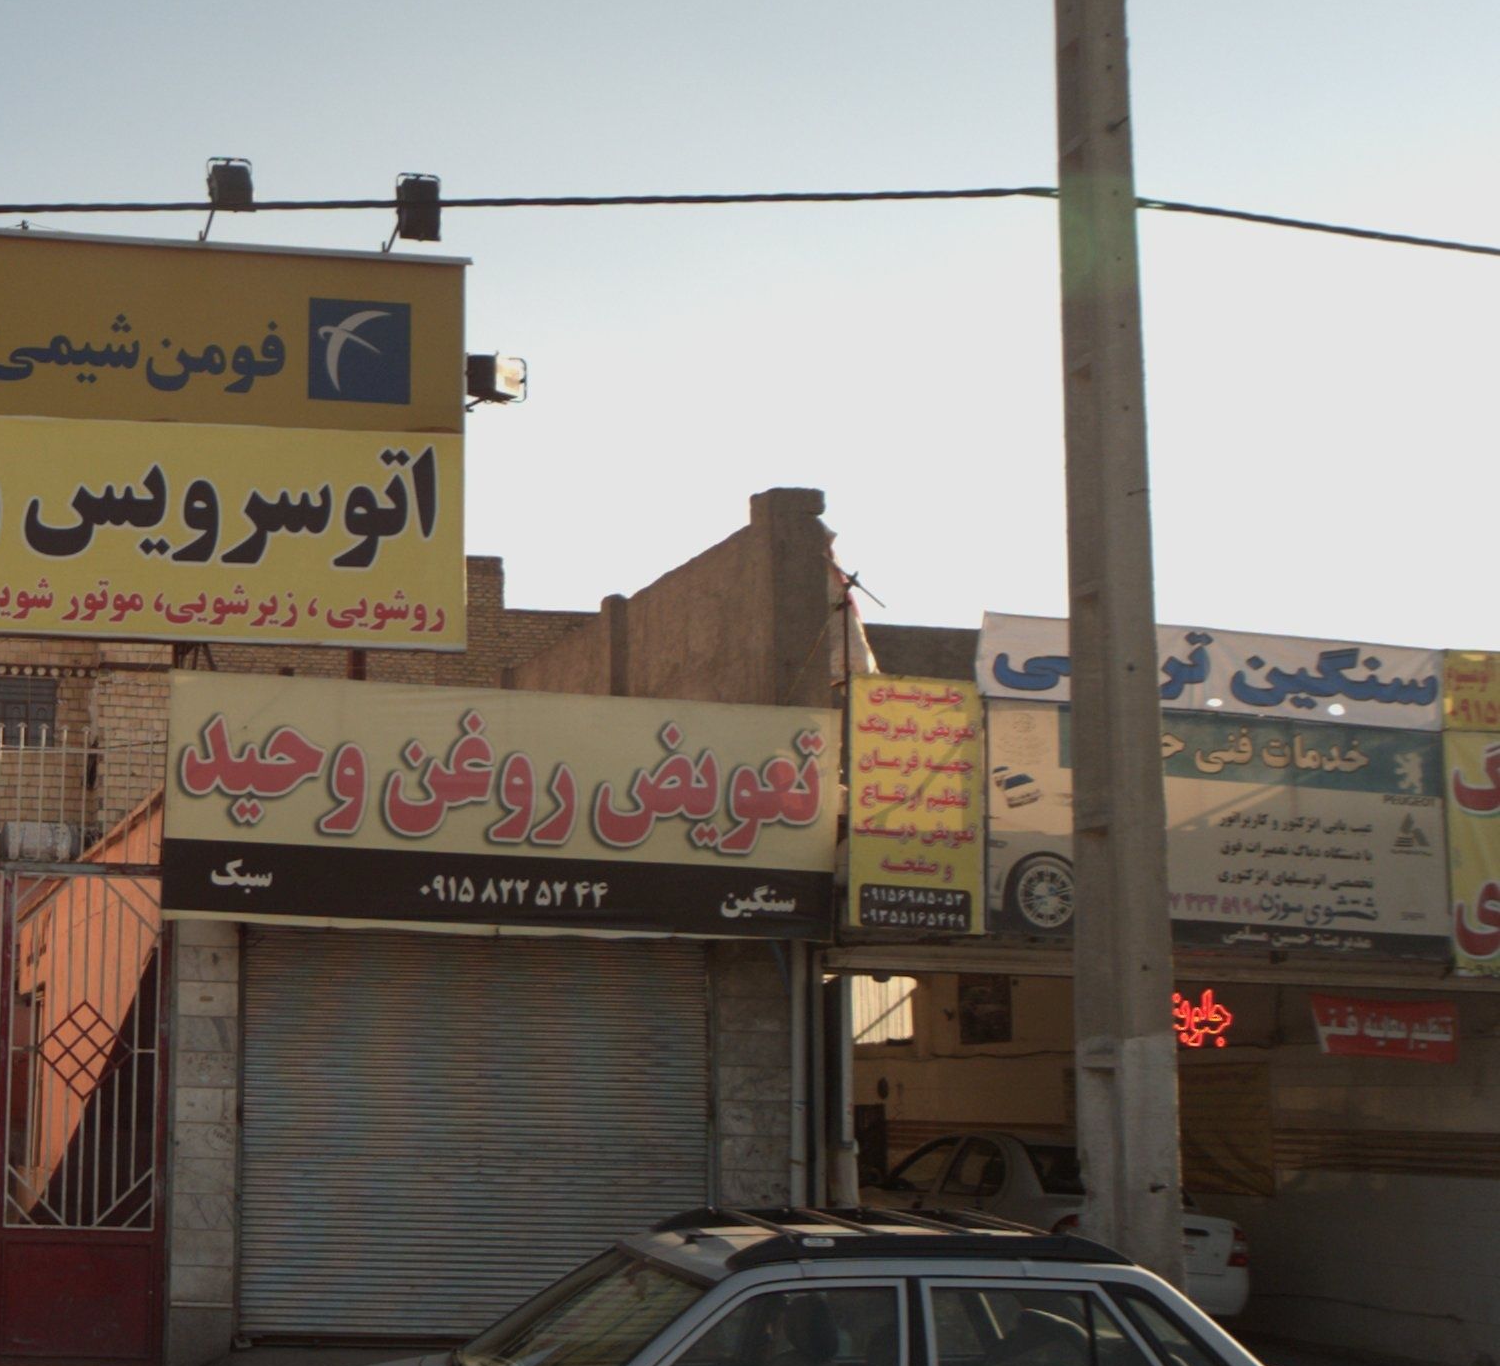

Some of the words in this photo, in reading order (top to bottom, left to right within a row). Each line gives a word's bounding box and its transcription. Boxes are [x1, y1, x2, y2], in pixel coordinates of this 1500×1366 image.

[146, 321, 287, 393] فومن
[61, 580, 144, 624] موتور
[1230, 647, 1438, 710] سنگین
[181, 713, 368, 835] وحید
[1195, 726, 1253, 773] فنی
[1262, 734, 1370, 772] خدمات
[386, 710, 577, 845] روغن
[595, 721, 826, 855] تعویض
[210, 859, 274, 897] سبک
[720, 883, 797, 918] سنگین
